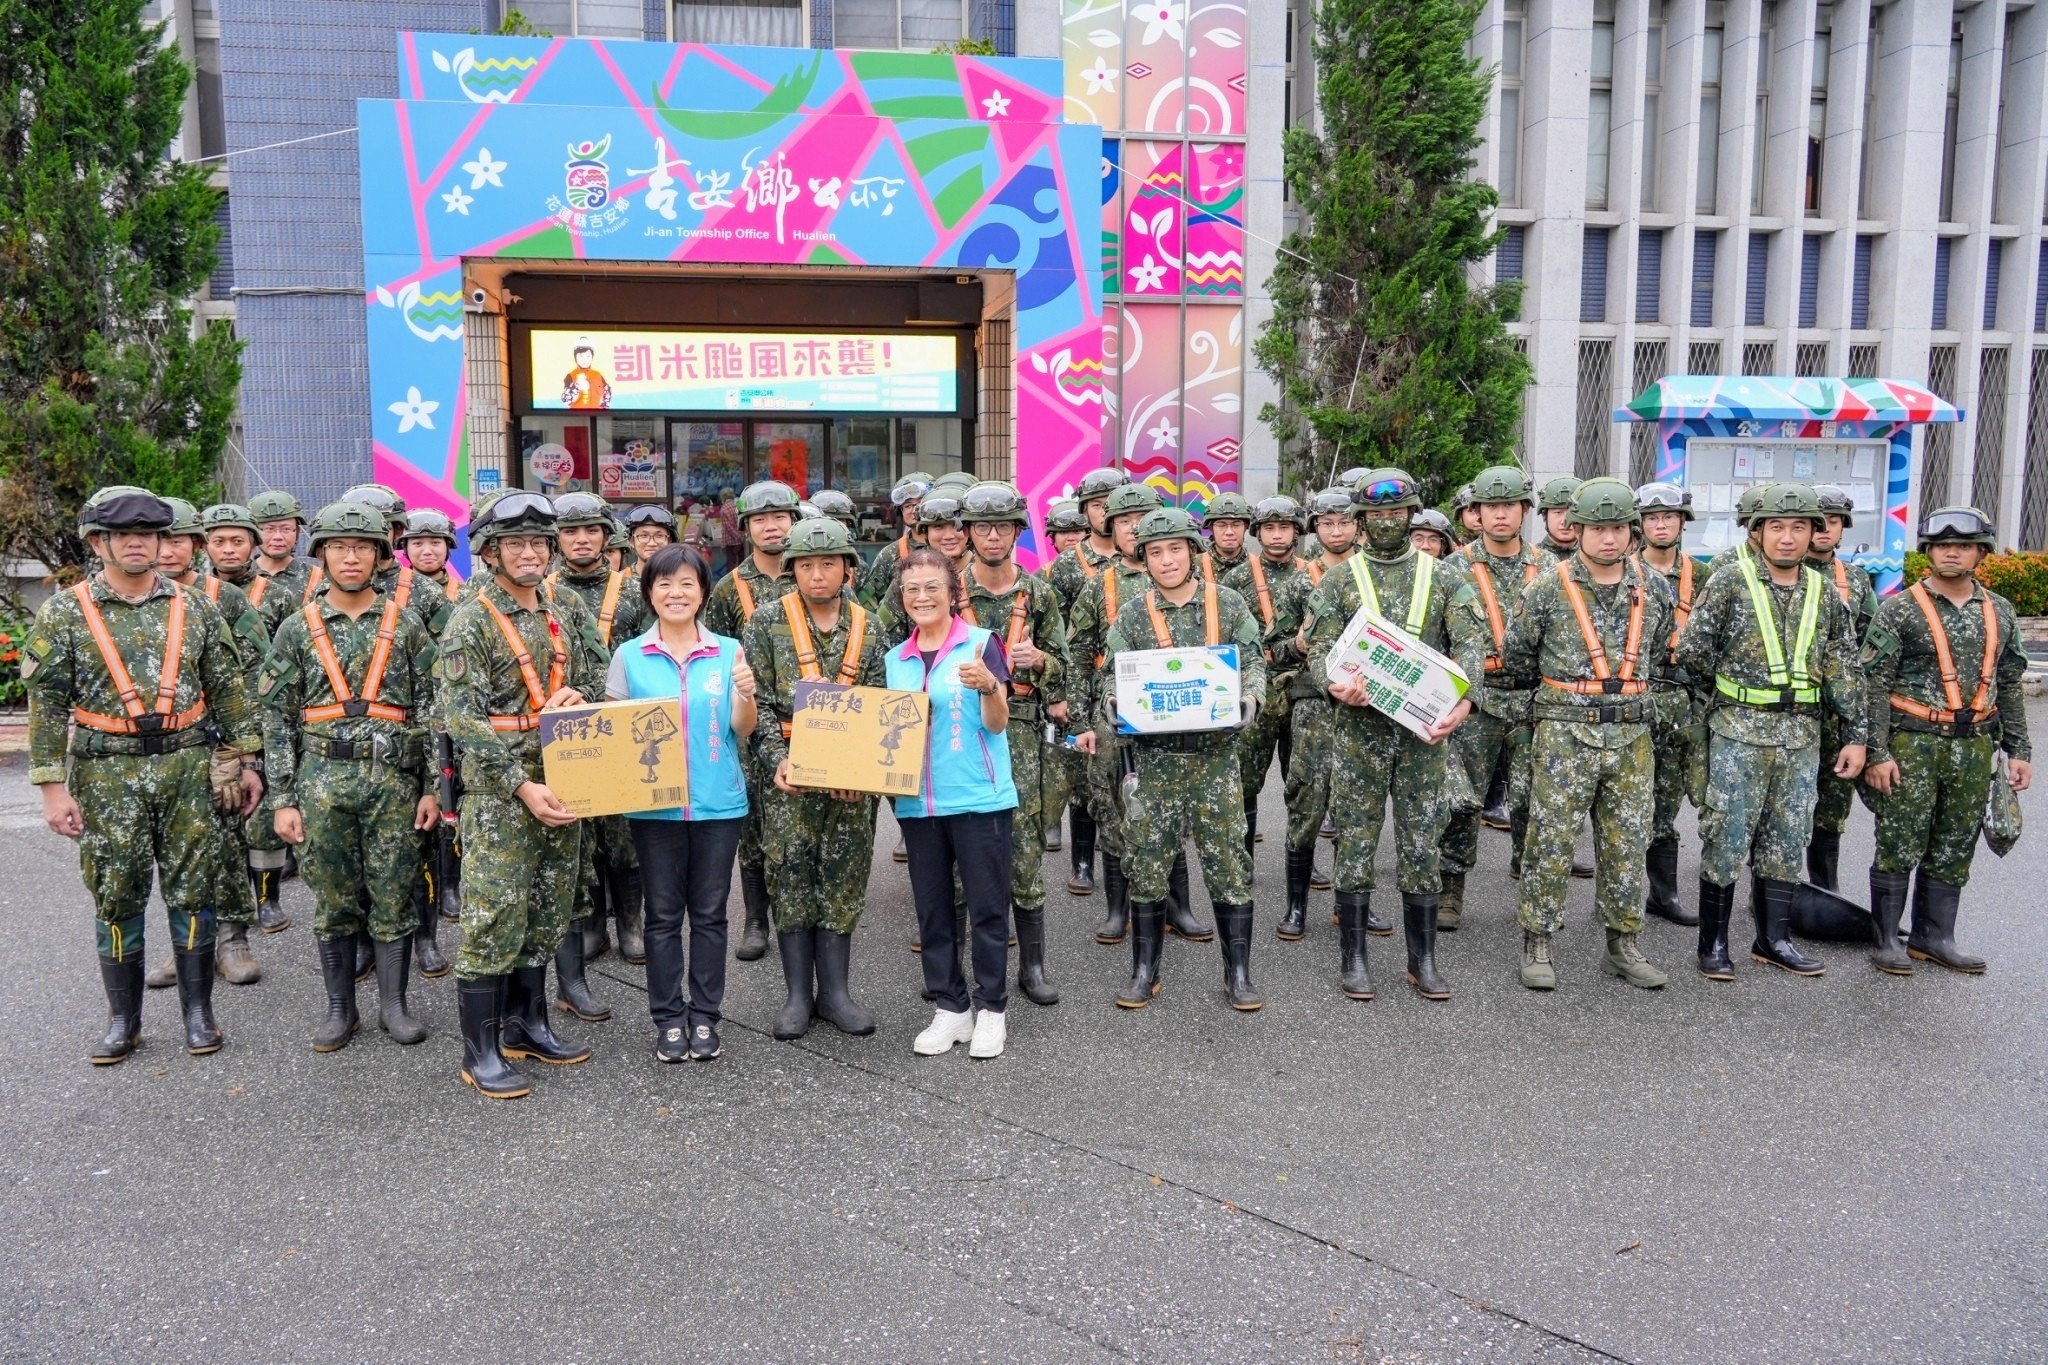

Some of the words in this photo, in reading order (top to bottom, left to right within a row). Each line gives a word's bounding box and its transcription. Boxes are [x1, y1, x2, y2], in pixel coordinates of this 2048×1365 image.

[626, 136, 905, 244] 吉安鄉公所
[545, 194, 630, 228] 花蓮縣吉安鄉
[603, 217, 630, 235] Hualien
[644, 226, 673, 237] Ji-an
[676, 226, 732, 240] Township
[735, 228, 770, 239] Office
[793, 230, 836, 241] Hualien
[614, 339, 892, 382] 凱米颱風來襲!
[1737, 420, 1837, 438] 公佈欄
[623, 473, 654, 481] Hualien
[1369, 644, 1423, 688] 每朝健康
[806, 689, 862, 714] 科學麵
[1358, 672, 1404, 715] 朝健康
[553, 715, 614, 741] 科學麵
